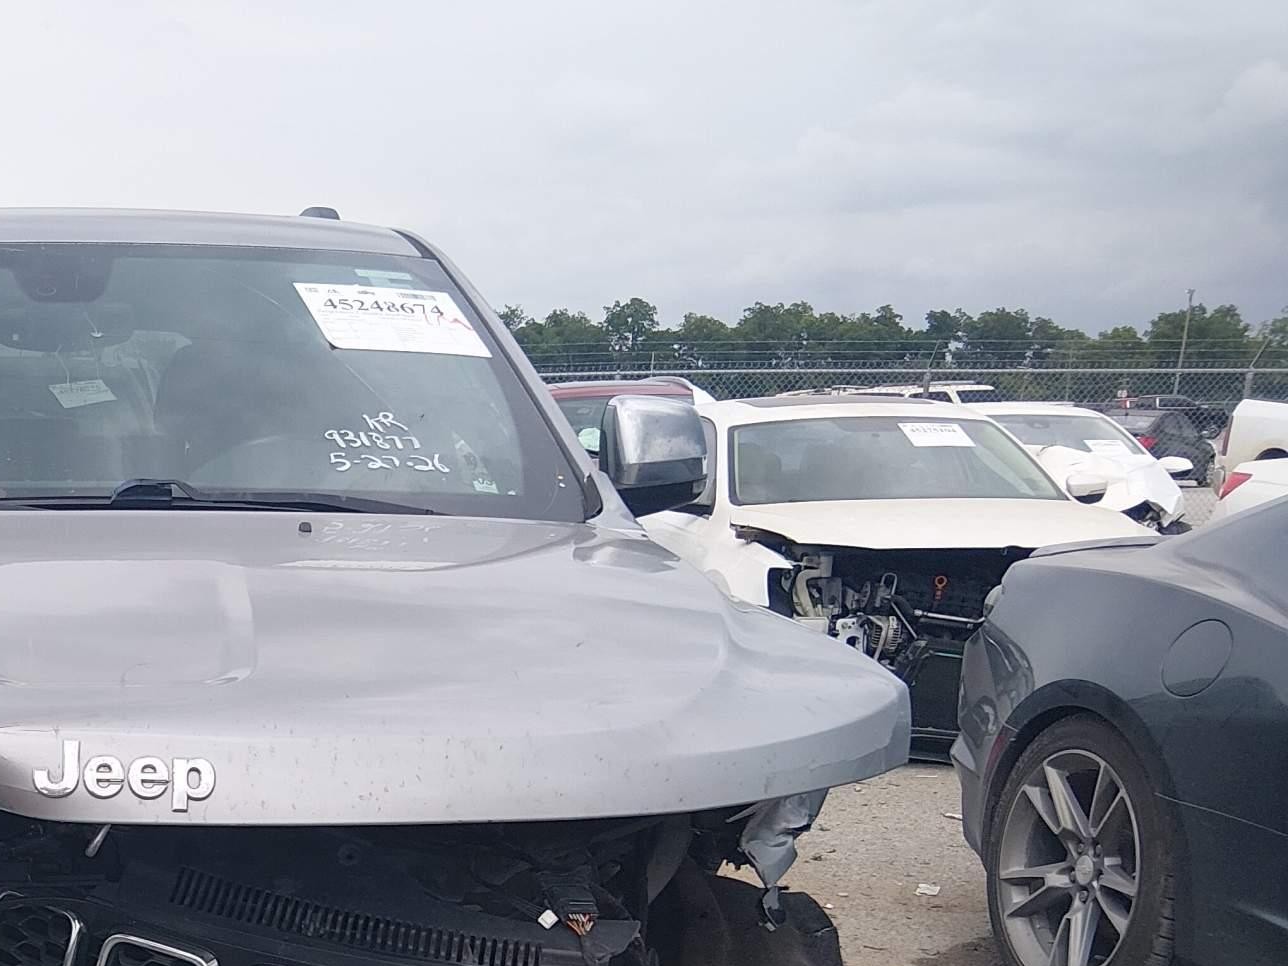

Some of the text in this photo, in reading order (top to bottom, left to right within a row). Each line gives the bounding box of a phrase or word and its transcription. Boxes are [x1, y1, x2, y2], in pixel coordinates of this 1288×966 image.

[323, 298, 444, 316] 45248674
[324, 430, 423, 449] 931877
[32, 739, 215, 812] Jeep
